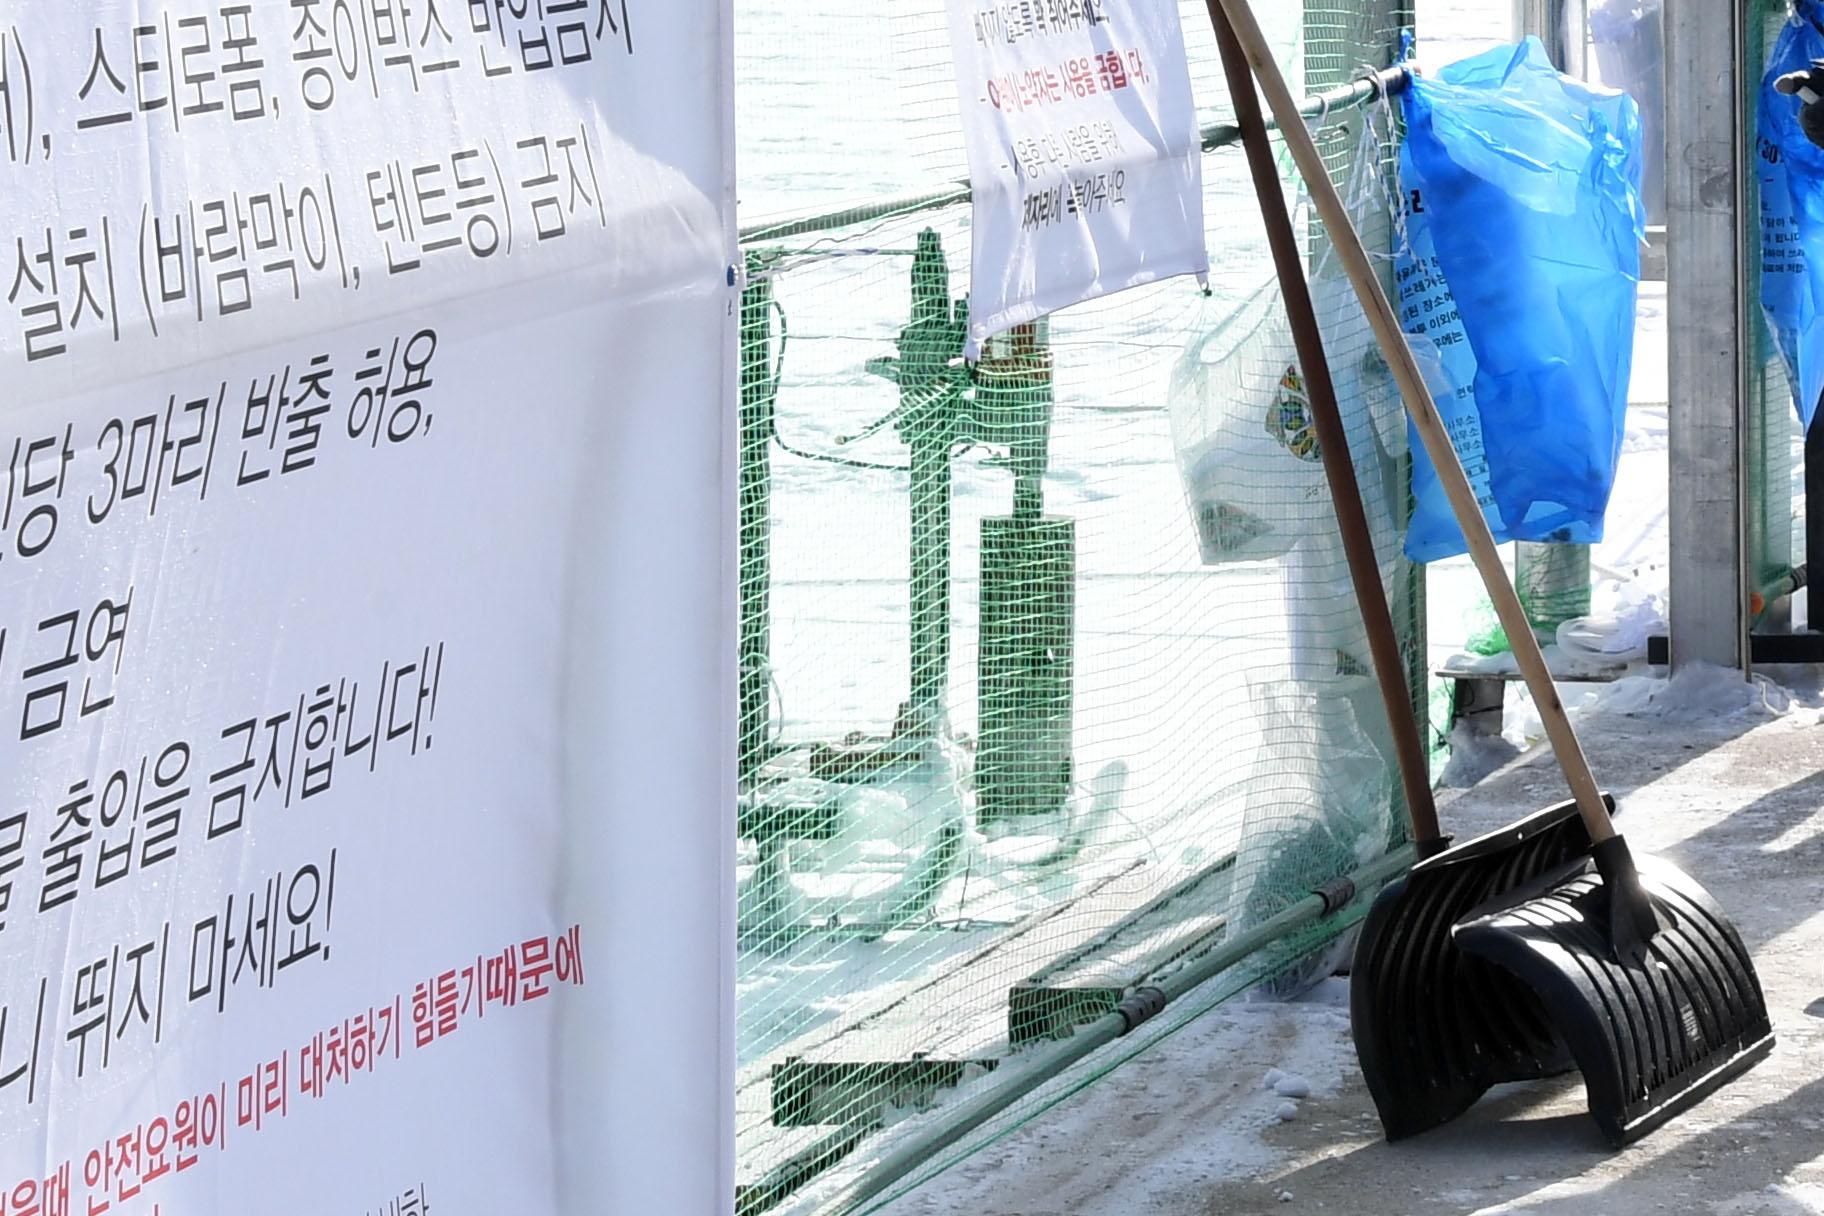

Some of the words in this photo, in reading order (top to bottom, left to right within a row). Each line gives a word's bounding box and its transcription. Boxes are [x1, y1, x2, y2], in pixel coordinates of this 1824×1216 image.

[76, 4, 281, 133] 스티로폼,
[1095, 48, 1150, 93] 금합다.
[7, 216, 121, 362] 설치
[365, 139, 512, 276] 텐트등)
[516, 124, 607, 242] 금지
[87, 381, 227, 524] 3마리
[236, 354, 334, 487] 반출
[347, 328, 437, 448] 허용,
[20, 585, 134, 741] 금연
[39, 741, 191, 914] 출입을
[207, 642, 444, 841] 금지합니다!
[67, 922, 169, 1078] 뛰지
[188, 848, 337, 1013] 마세요!
[84, 1081, 226, 1216] 안전요원이
[238, 1050, 288, 1131] 미리
[300, 994, 401, 1098] 대처하기
[412, 924, 585, 1049] 힘들기때문에
